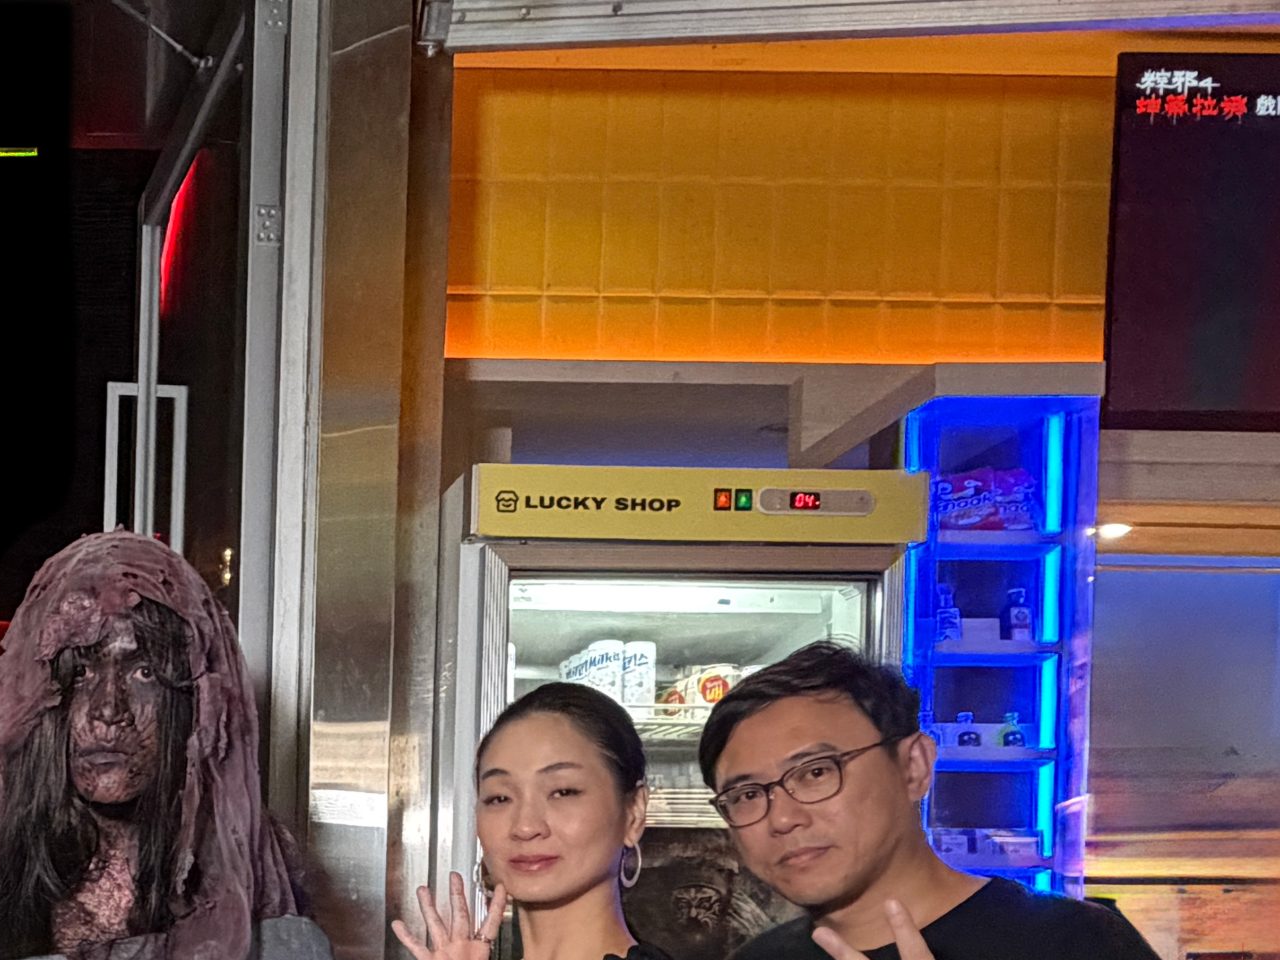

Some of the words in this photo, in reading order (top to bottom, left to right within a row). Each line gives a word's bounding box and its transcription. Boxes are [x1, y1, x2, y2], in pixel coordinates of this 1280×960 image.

[1255, 94, 1280, 116] 戲
[524, 495, 607, 511] LUCKY
[614, 497, 681, 512] SHOP
